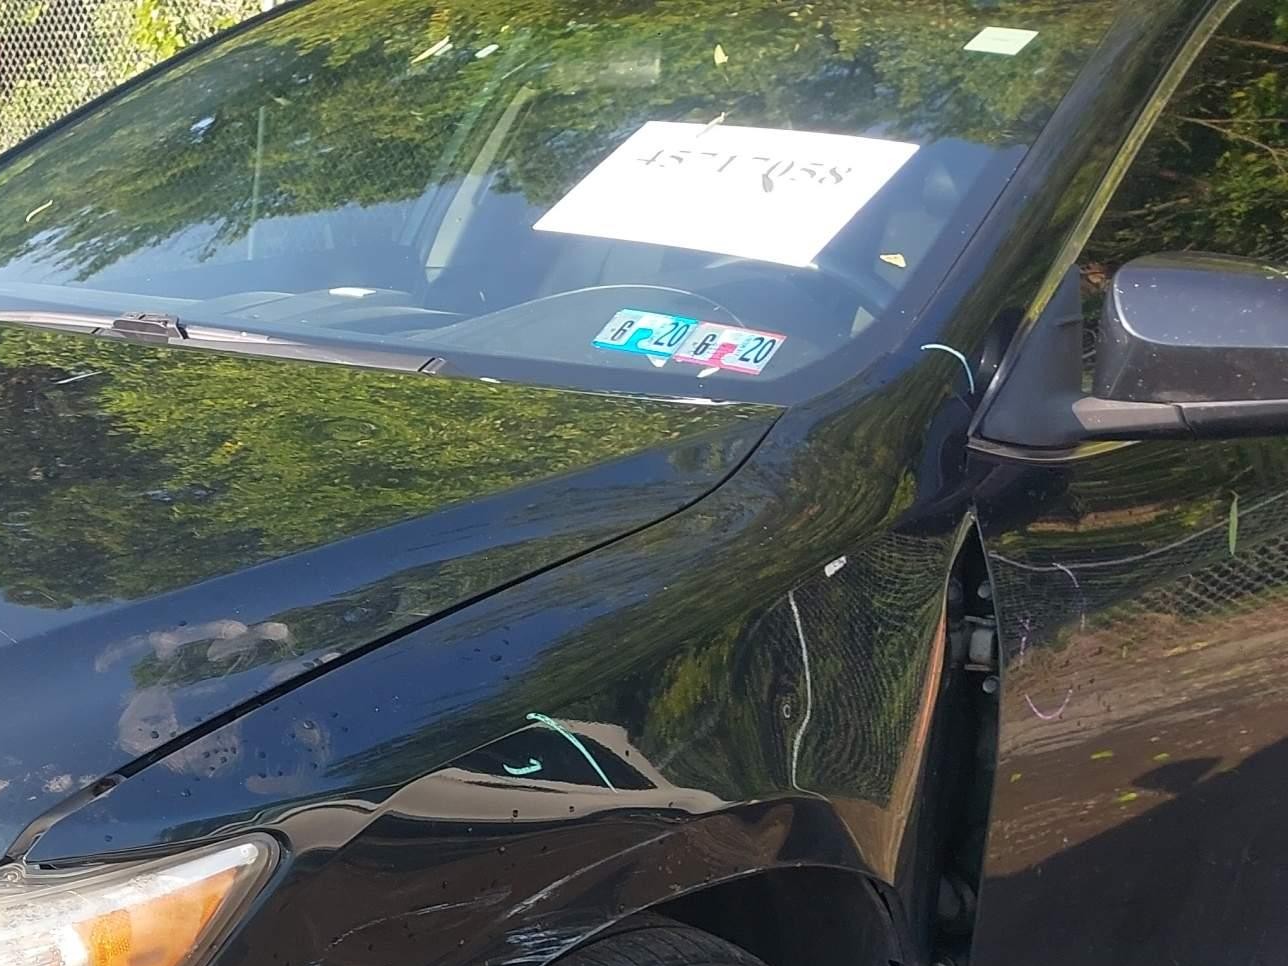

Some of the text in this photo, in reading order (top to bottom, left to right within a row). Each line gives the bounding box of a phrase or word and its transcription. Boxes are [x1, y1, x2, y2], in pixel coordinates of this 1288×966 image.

[611, 320, 690, 348] 6 20
[693, 333, 715, 356] 6
[739, 336, 777, 364] 20
